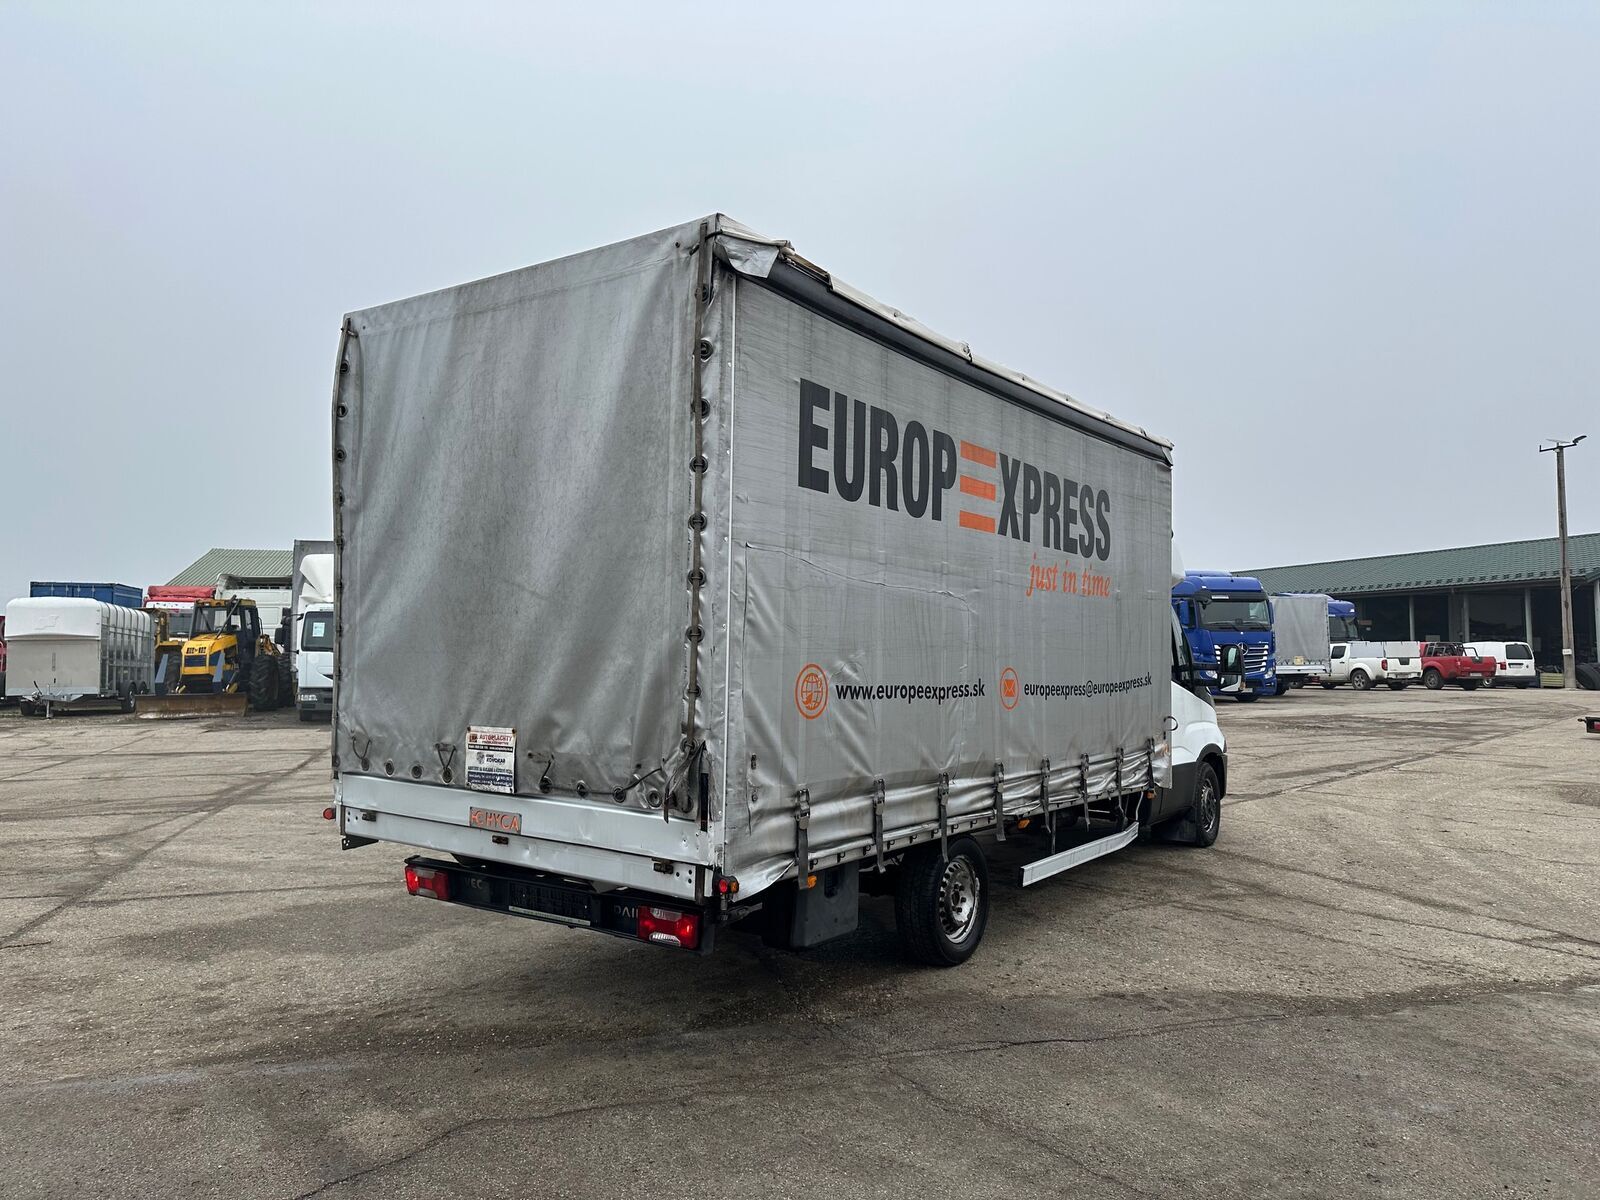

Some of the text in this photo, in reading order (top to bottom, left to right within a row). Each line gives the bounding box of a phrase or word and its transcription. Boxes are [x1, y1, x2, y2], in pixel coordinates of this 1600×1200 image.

[1025, 552, 1111, 598] just in time
[835, 678, 986, 705] www.europeexpress.sk
[1023, 672, 1152, 701] europeexpress@europeexpress.sk
